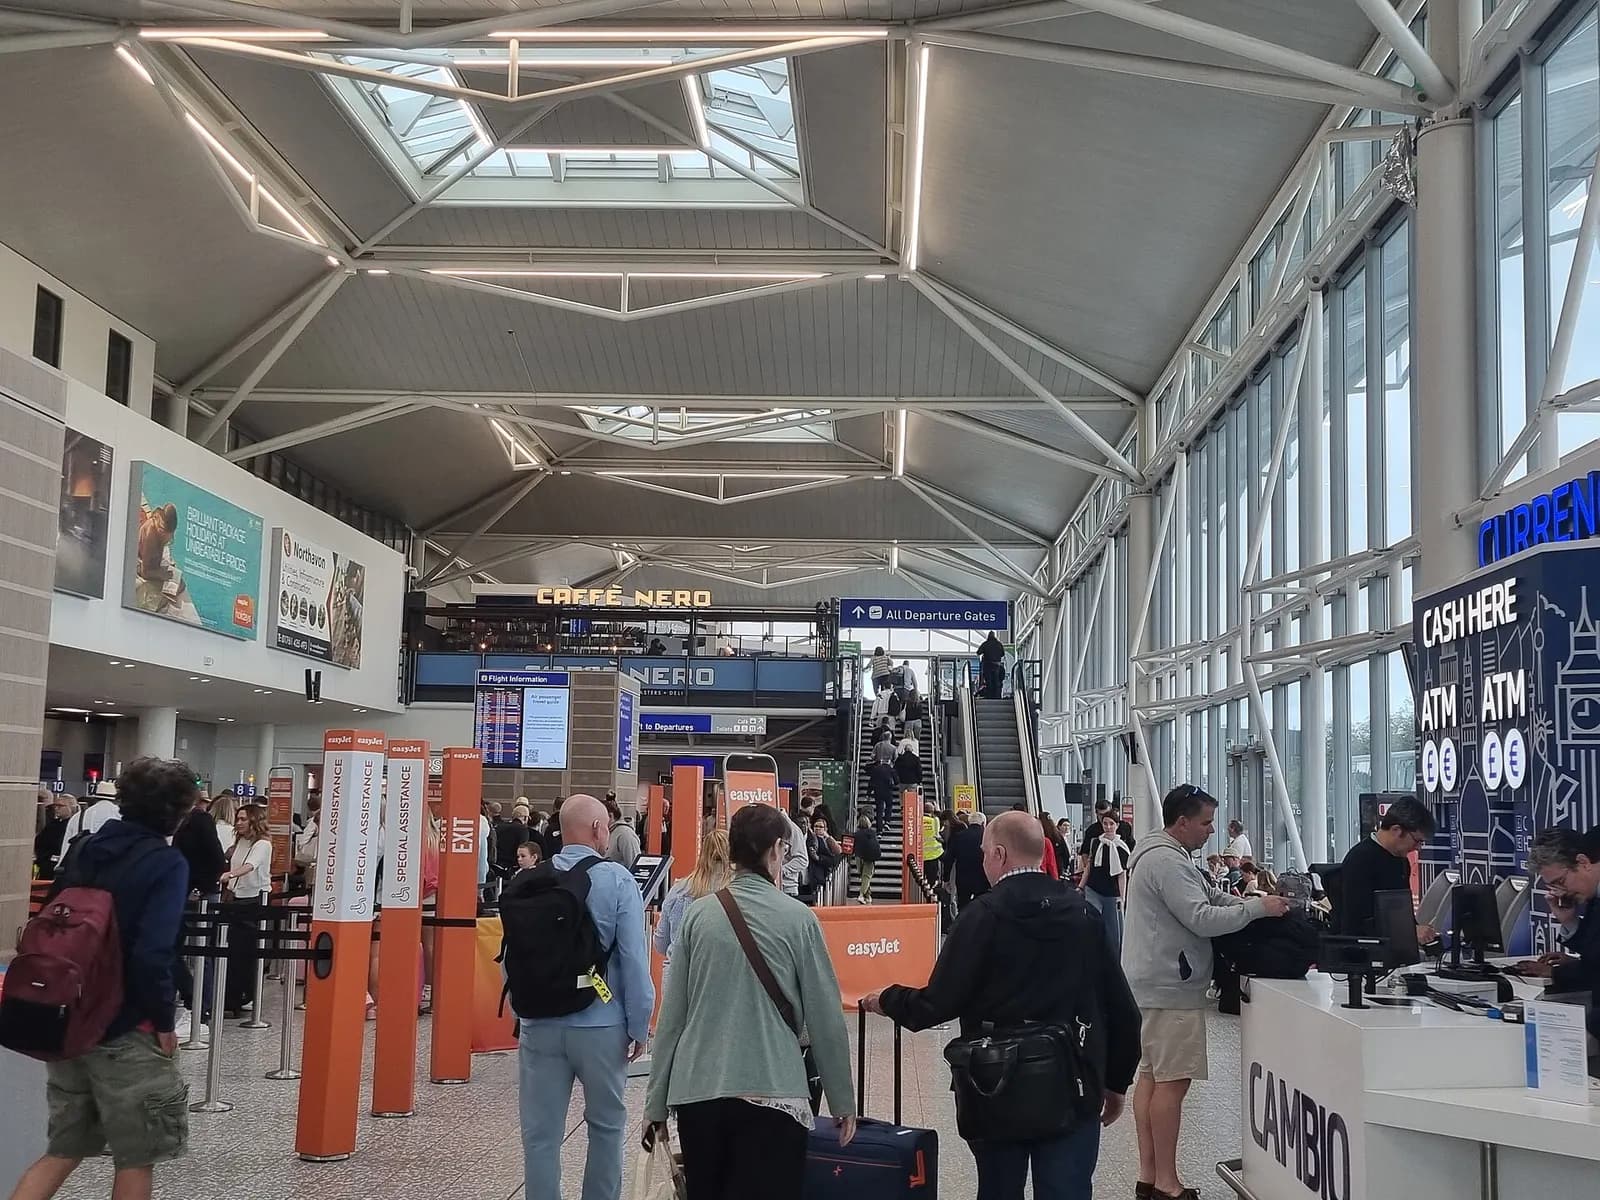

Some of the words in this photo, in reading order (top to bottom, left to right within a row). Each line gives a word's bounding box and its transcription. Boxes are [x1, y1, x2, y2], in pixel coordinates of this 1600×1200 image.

[187, 506, 218, 532] BRILLIANT
[218, 520, 247, 544] PACKAGE
[1478, 472, 1600, 568] CURREN
[186, 521, 217, 547] HOLIDAYS
[217, 536, 226, 550] AT
[185, 536, 226, 565] UNBEATABLE
[536, 584, 623, 606] CAFFÈ
[634, 589, 712, 607] NERO
[886, 609, 902, 620] All
[905, 610, 961, 623] Departure
[964, 611, 996, 622] Gates
[1423, 597, 1465, 648] CASH
[1468, 577, 1517, 635] HERE
[488, 674, 508, 684] Flight
[509, 675, 548, 683] Information
[629, 667, 715, 686] NERO
[1421, 684, 1457, 732] ATM
[1481, 668, 1526, 722] ATM
[328, 736, 352, 745] easyJet
[357, 736, 383, 746] easyJet
[654, 722, 694, 732] Departures
[392, 745, 421, 753] easyJet
[453, 752, 480, 760] easyJet
[52, 781, 64, 792] 10
[236, 785, 244, 796] 8
[248, 786, 255, 796] 5
[331, 759, 343, 836] ASSISTANCE
[360, 759, 373, 836] ASSISTANCE
[399, 765, 411, 833] ASSISTANCE
[730, 788, 773, 803] easyJet
[452, 816, 474, 853] EXIT
[907, 817, 915, 846] easyJet
[326, 838, 337, 892] SPECIAL
[356, 839, 368, 893] SPECIAL
[397, 836, 409, 882] SPECIAL
[847, 937, 900, 958] easyJet
[1249, 1061, 1351, 1200] CAMBIO
